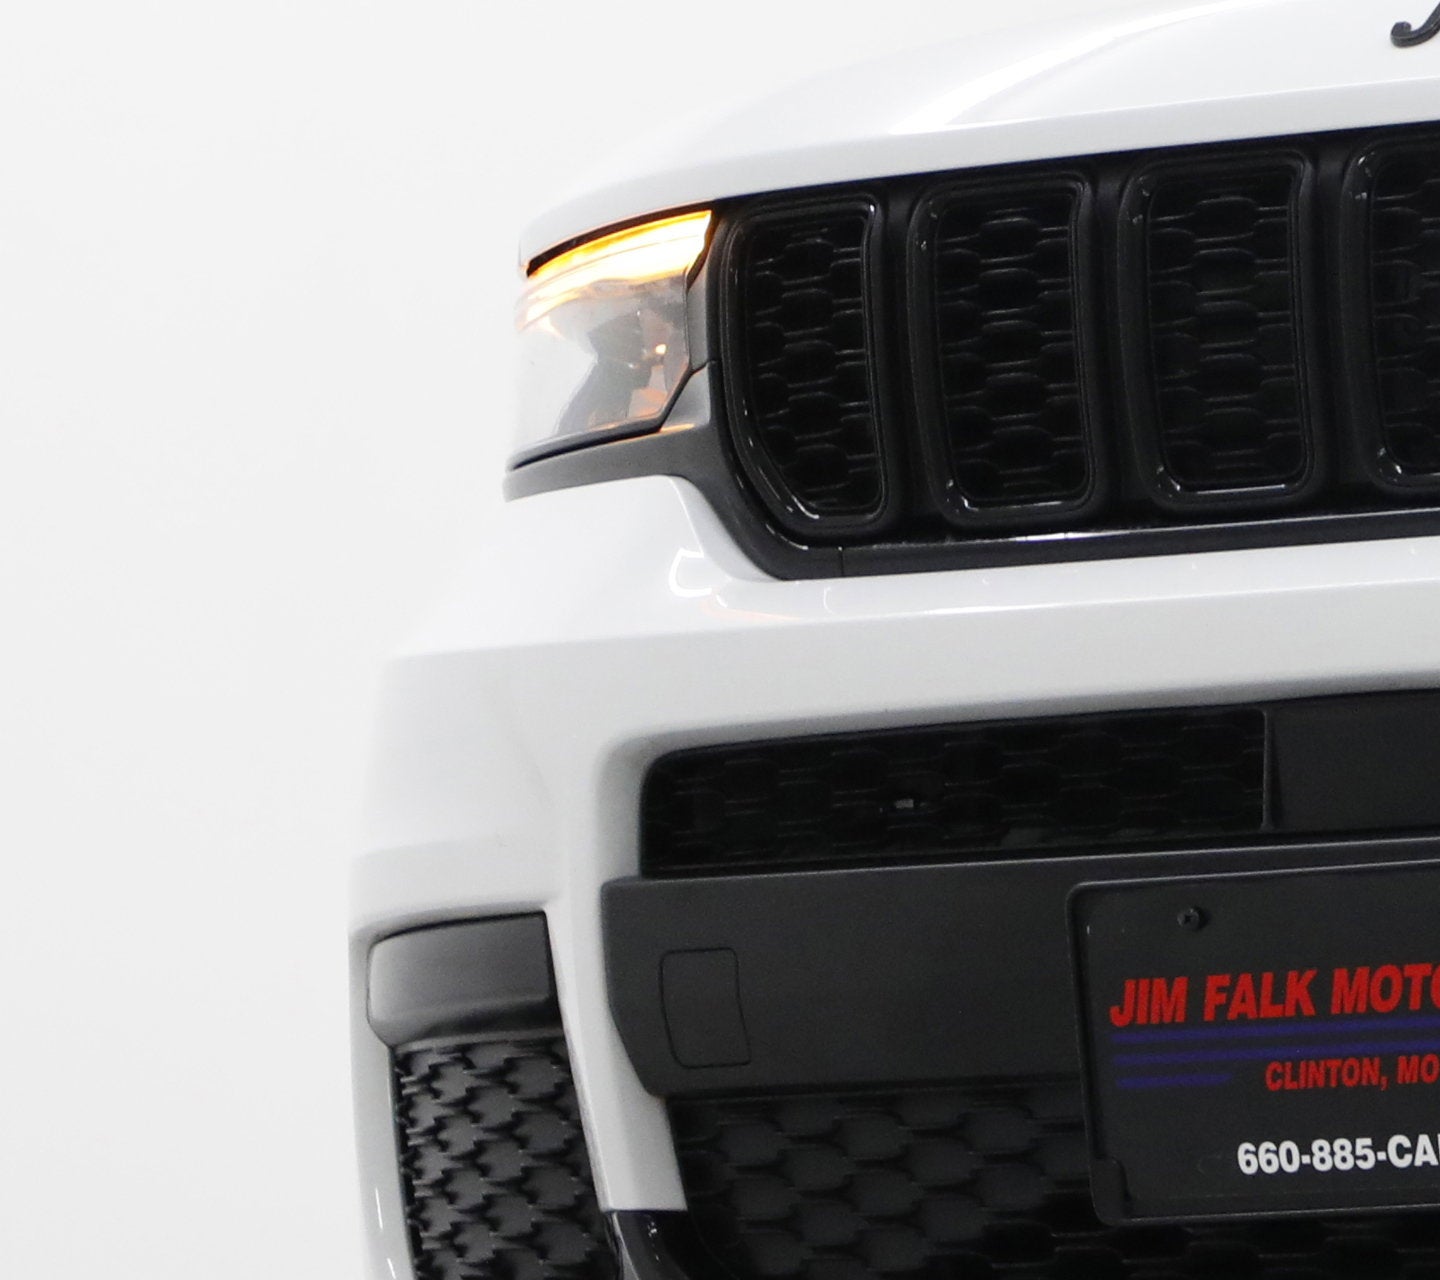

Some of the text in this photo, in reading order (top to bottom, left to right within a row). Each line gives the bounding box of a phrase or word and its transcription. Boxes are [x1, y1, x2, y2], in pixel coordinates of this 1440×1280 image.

[1110, 977, 1189, 1027] JIM
[1203, 969, 1317, 1021] FALK
[1265, 1054, 1440, 1091] CLINTON, MO
